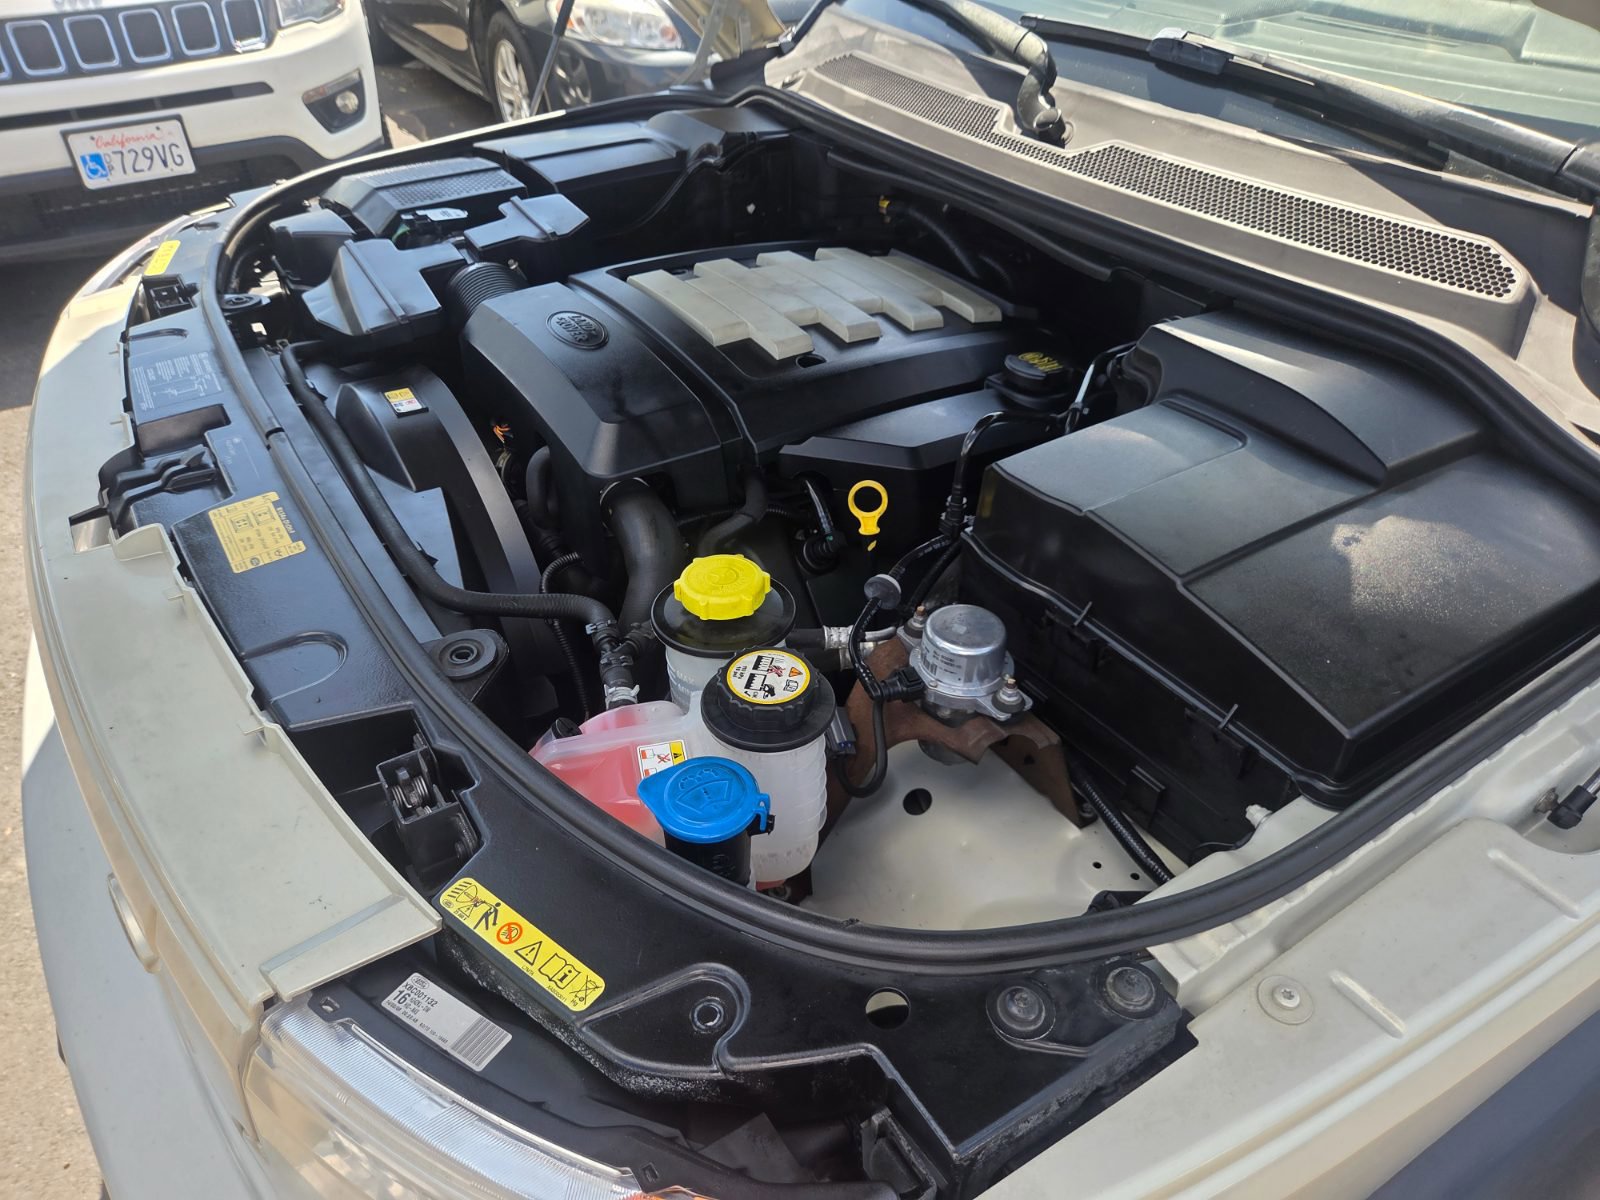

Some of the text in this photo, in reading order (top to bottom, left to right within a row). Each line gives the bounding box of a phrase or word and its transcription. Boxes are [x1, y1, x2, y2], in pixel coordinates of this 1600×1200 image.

[96, 133, 160, 149] California
[111, 143, 185, 175] 729VG
[392, 989, 411, 1005] 16
